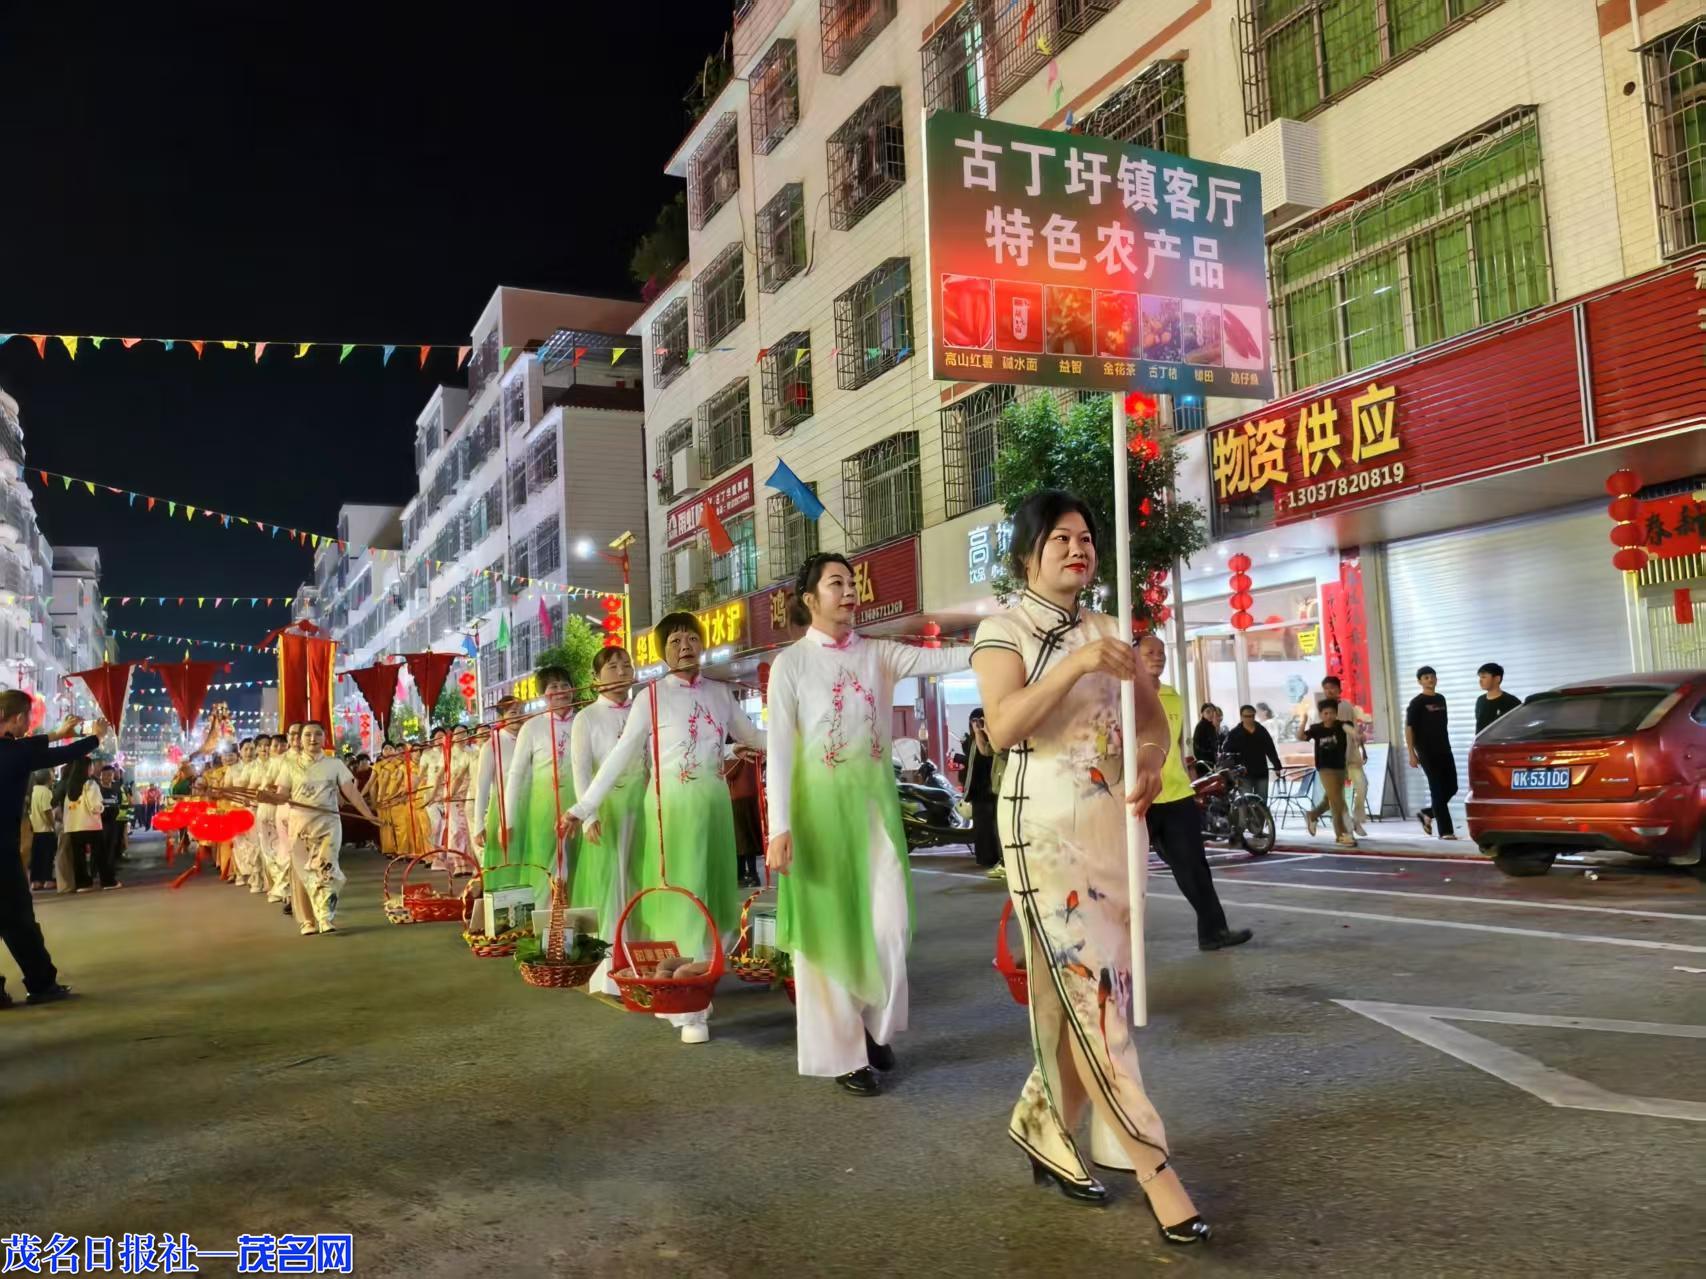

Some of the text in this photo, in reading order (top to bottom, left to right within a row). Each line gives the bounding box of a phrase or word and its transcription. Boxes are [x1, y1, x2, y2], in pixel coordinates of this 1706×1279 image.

[954, 129, 1242, 228] 古丁圩镇客厅
[985, 204, 1225, 290] 特色农产品
[1212, 382, 1400, 498] 物资供应
